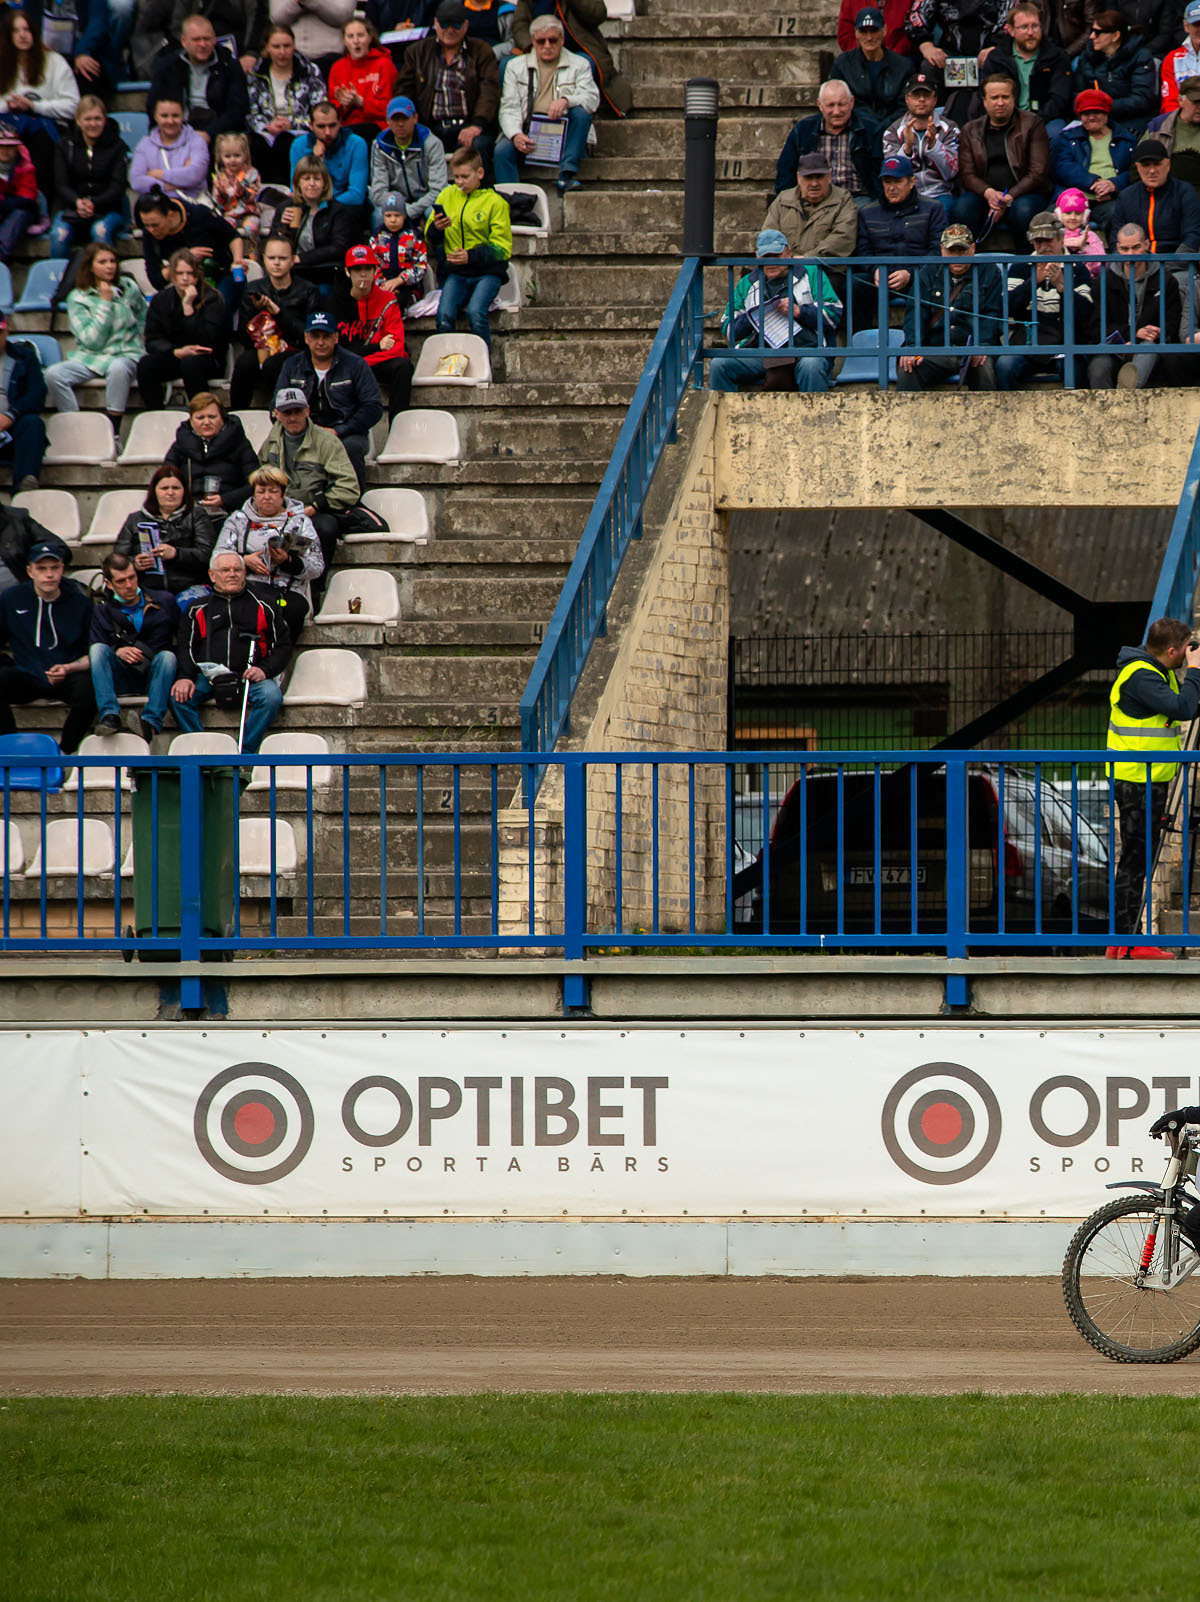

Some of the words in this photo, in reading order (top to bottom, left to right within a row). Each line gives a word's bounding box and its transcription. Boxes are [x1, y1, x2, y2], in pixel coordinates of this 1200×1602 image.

[777, 17, 796, 34] 12
[746, 88, 764, 104] 11
[723, 160, 742, 177] 10
[533, 624, 543, 641] 4
[487, 707, 498, 724] 3
[440, 789, 452, 808] 2
[341, 1075, 669, 1147] OPTIBET
[342, 1156, 522, 1172] SPORTA
[558, 1152, 669, 1172] BĀRS
